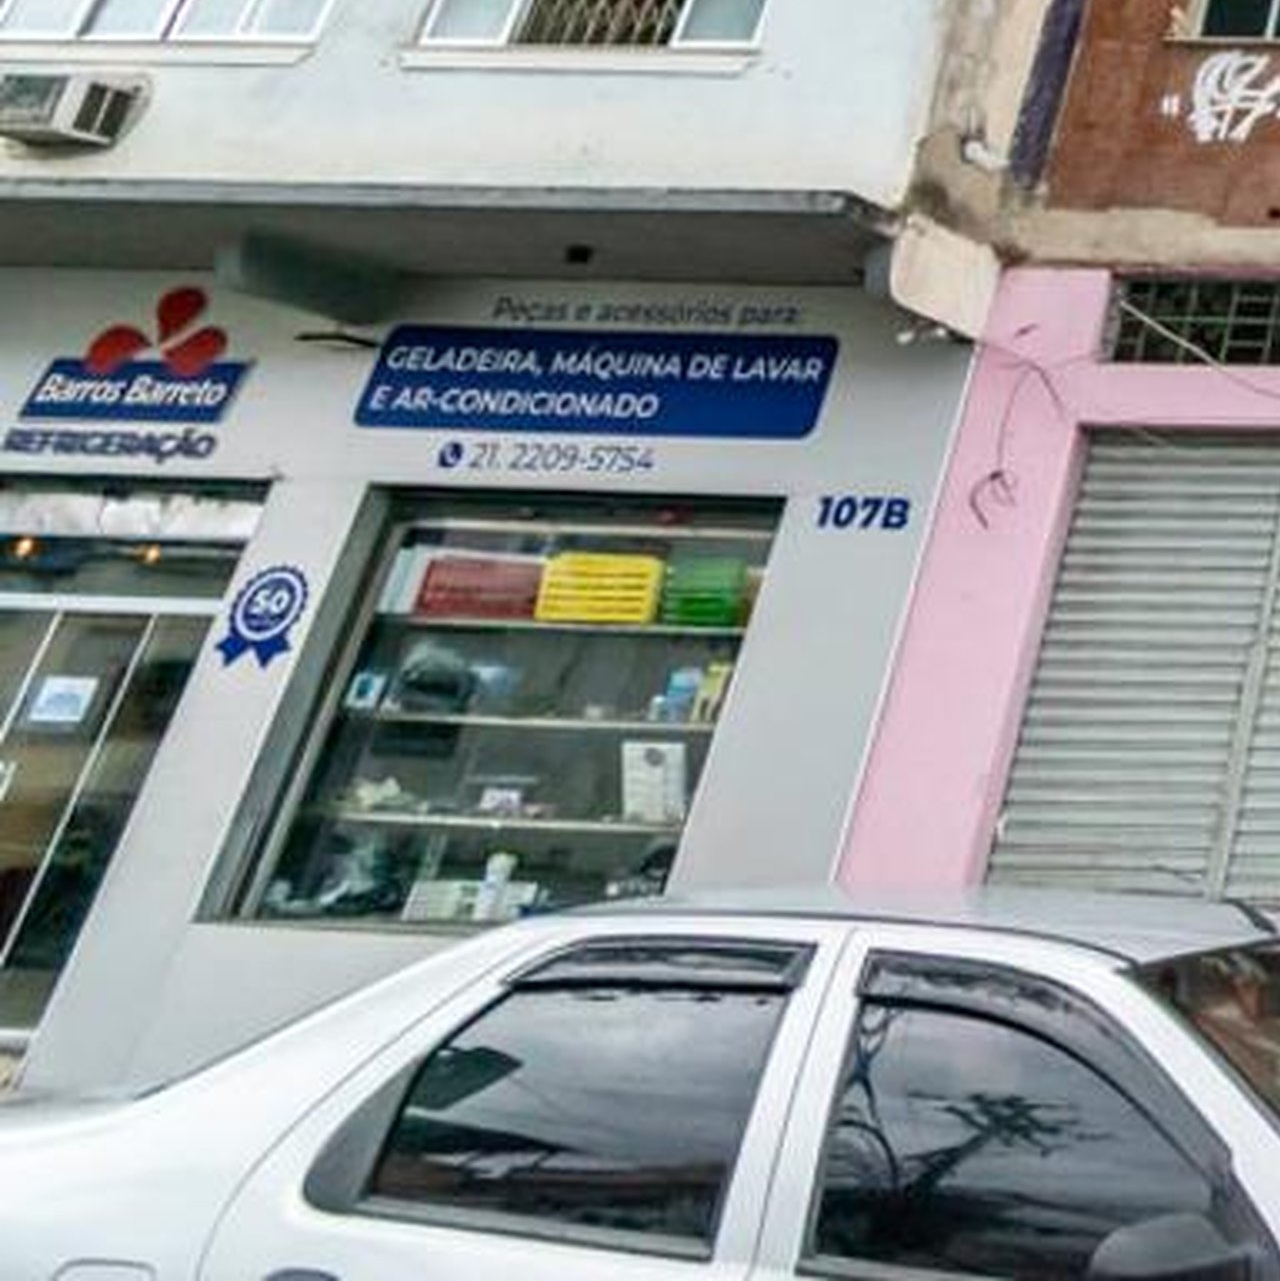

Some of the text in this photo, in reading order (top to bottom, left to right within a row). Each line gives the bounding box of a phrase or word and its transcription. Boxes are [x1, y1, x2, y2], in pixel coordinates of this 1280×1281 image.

[387, 344, 824, 381] GELADEIRA, MÁQUINA DE LAVAR
[35, 372, 228, 406] Barros Barreto
[369, 385, 658, 418] E AR-CONDICIONADO
[2, 427, 217, 464] REFRIGERAÇÃO
[508, 442, 656, 472] 2209-5754
[817, 495, 911, 530] 107B
